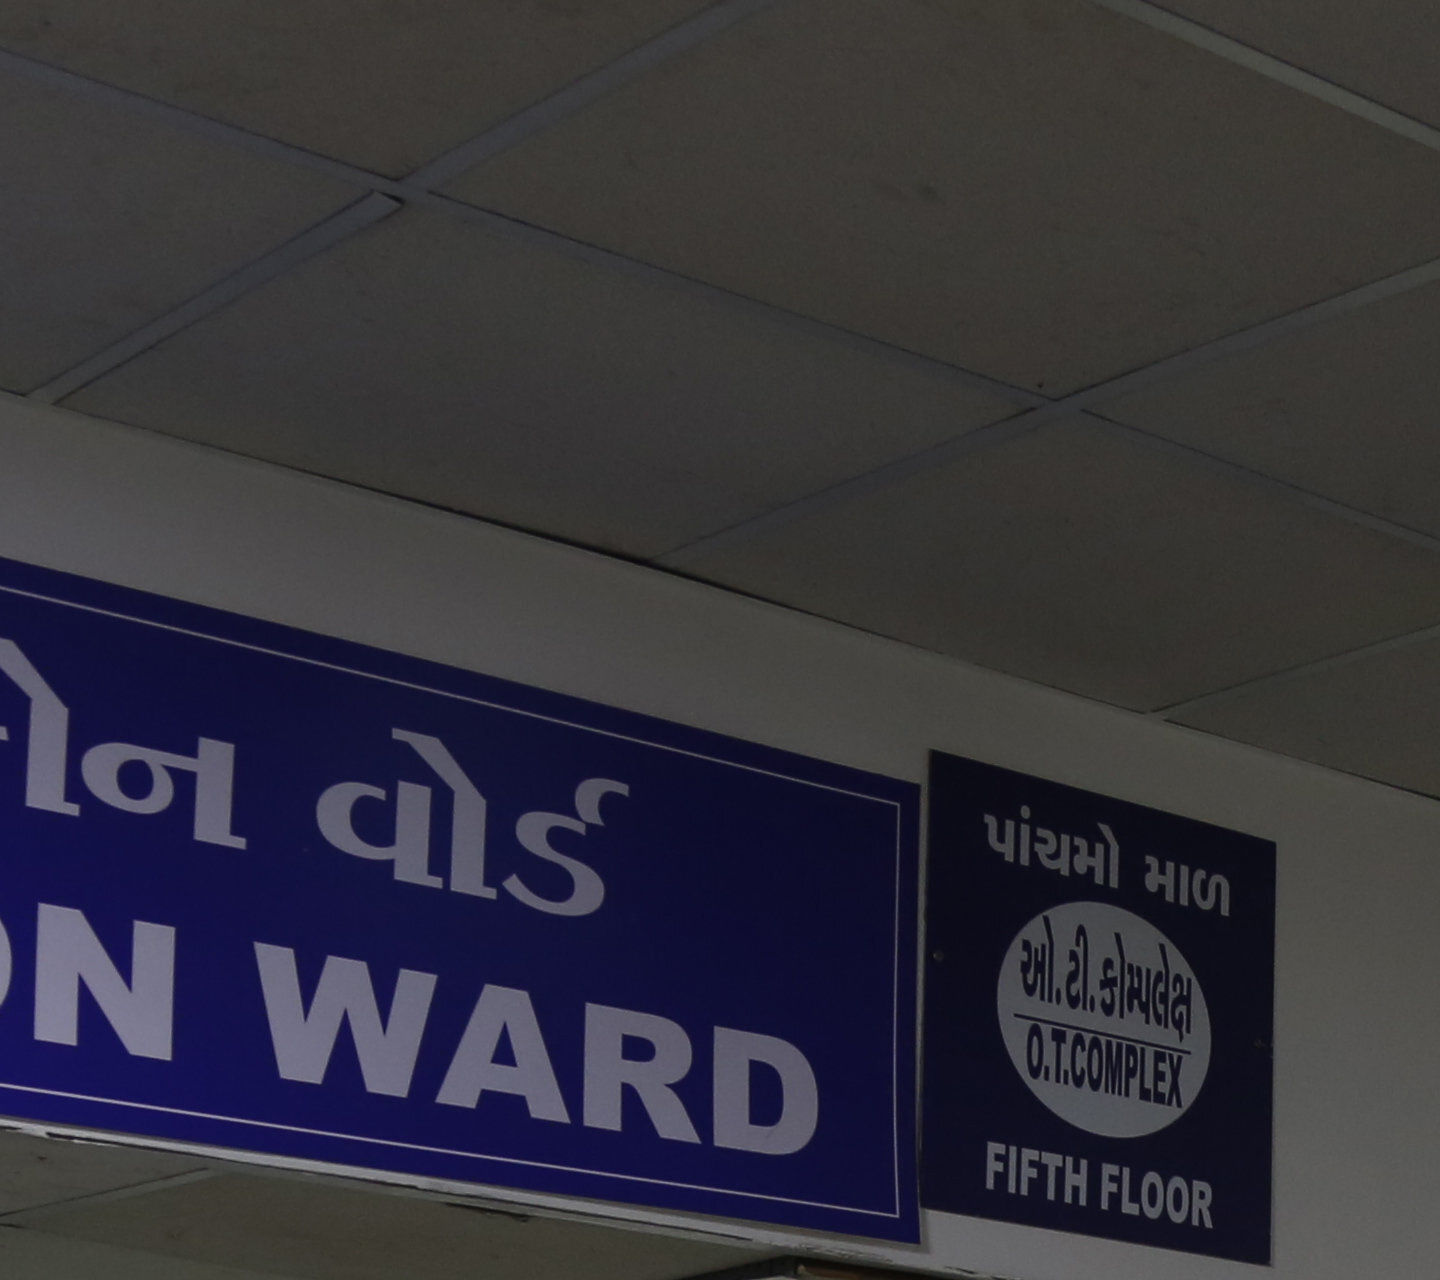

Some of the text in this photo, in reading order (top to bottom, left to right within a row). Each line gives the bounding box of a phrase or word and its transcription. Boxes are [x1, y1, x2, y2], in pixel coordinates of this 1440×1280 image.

[316, 729, 629, 915] વોર્ડ
[984, 805, 1230, 916] પાંચમો માળ
[254, 941, 818, 1154] WARD
[986, 1141, 1213, 1228] FIFTH FLOOR
